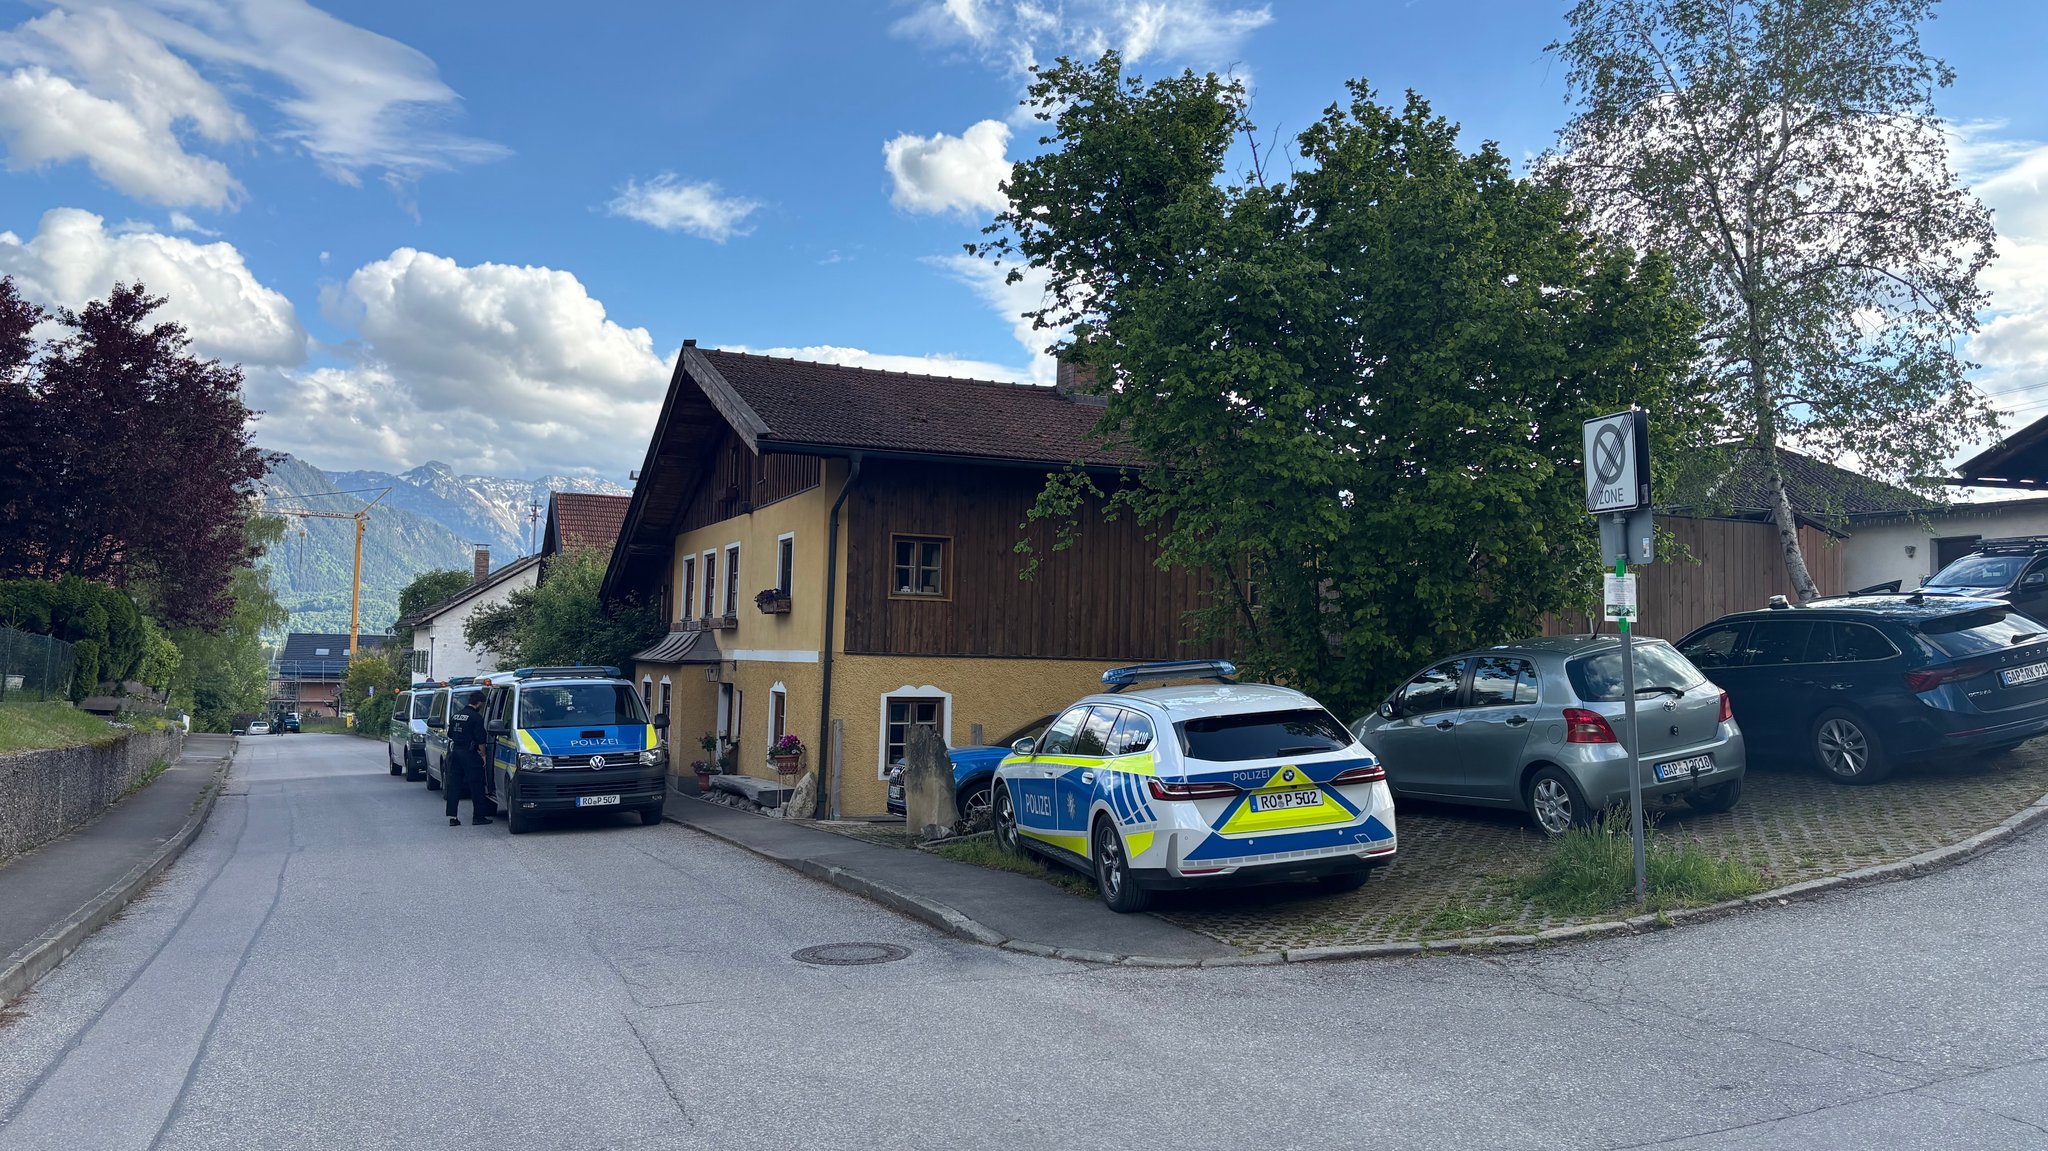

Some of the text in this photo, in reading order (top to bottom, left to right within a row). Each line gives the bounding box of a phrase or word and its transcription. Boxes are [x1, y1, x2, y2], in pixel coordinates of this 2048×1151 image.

[1599, 487, 1624, 505] ZONE
[2006, 663, 2048, 683] GAP RK 911
[570, 738, 619, 747] POLIZEI
[1137, 732, 1149, 745] 110
[1233, 769, 1270, 781] POLIZEI
[1662, 763, 1677, 776] GAP
[1683, 761, 1689, 772] J
[582, 797, 593, 805] RO
[1025, 793, 1052, 817] POLIZEI
[1261, 791, 1318, 809] RO P 502
